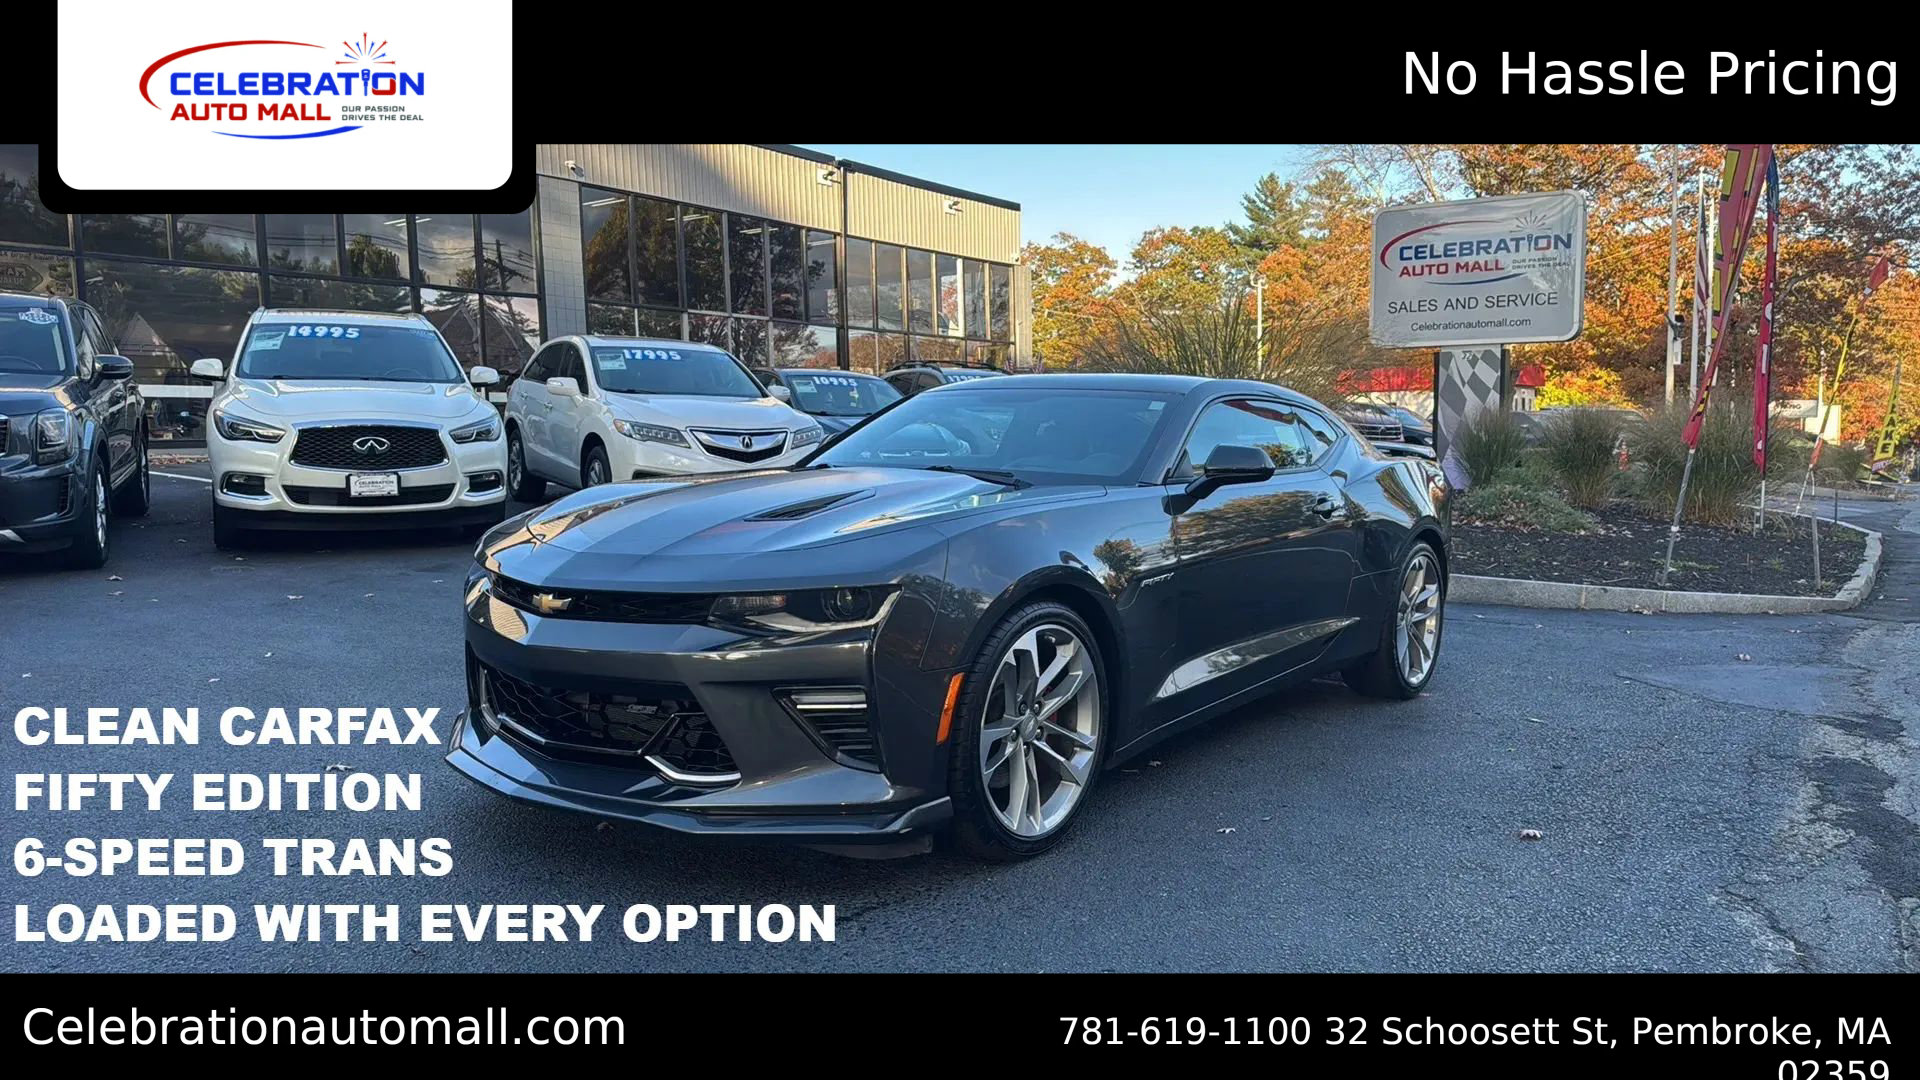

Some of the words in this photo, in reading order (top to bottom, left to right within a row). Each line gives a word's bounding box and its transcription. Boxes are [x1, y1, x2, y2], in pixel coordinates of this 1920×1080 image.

[1399, 232, 1572, 261] CELEBRATION
[1399, 263, 1449, 278] AUTO
[1455, 259, 1505, 274] MALL
[1387, 299, 1438, 315] SALES
[1443, 296, 1479, 311] AND
[1484, 291, 1558, 308] SERVICE
[287, 325, 360, 339] 14995
[1410, 318, 1532, 332] Celebrationautomall.com
[623, 349, 682, 361] 17995
[812, 376, 858, 387] 10995
